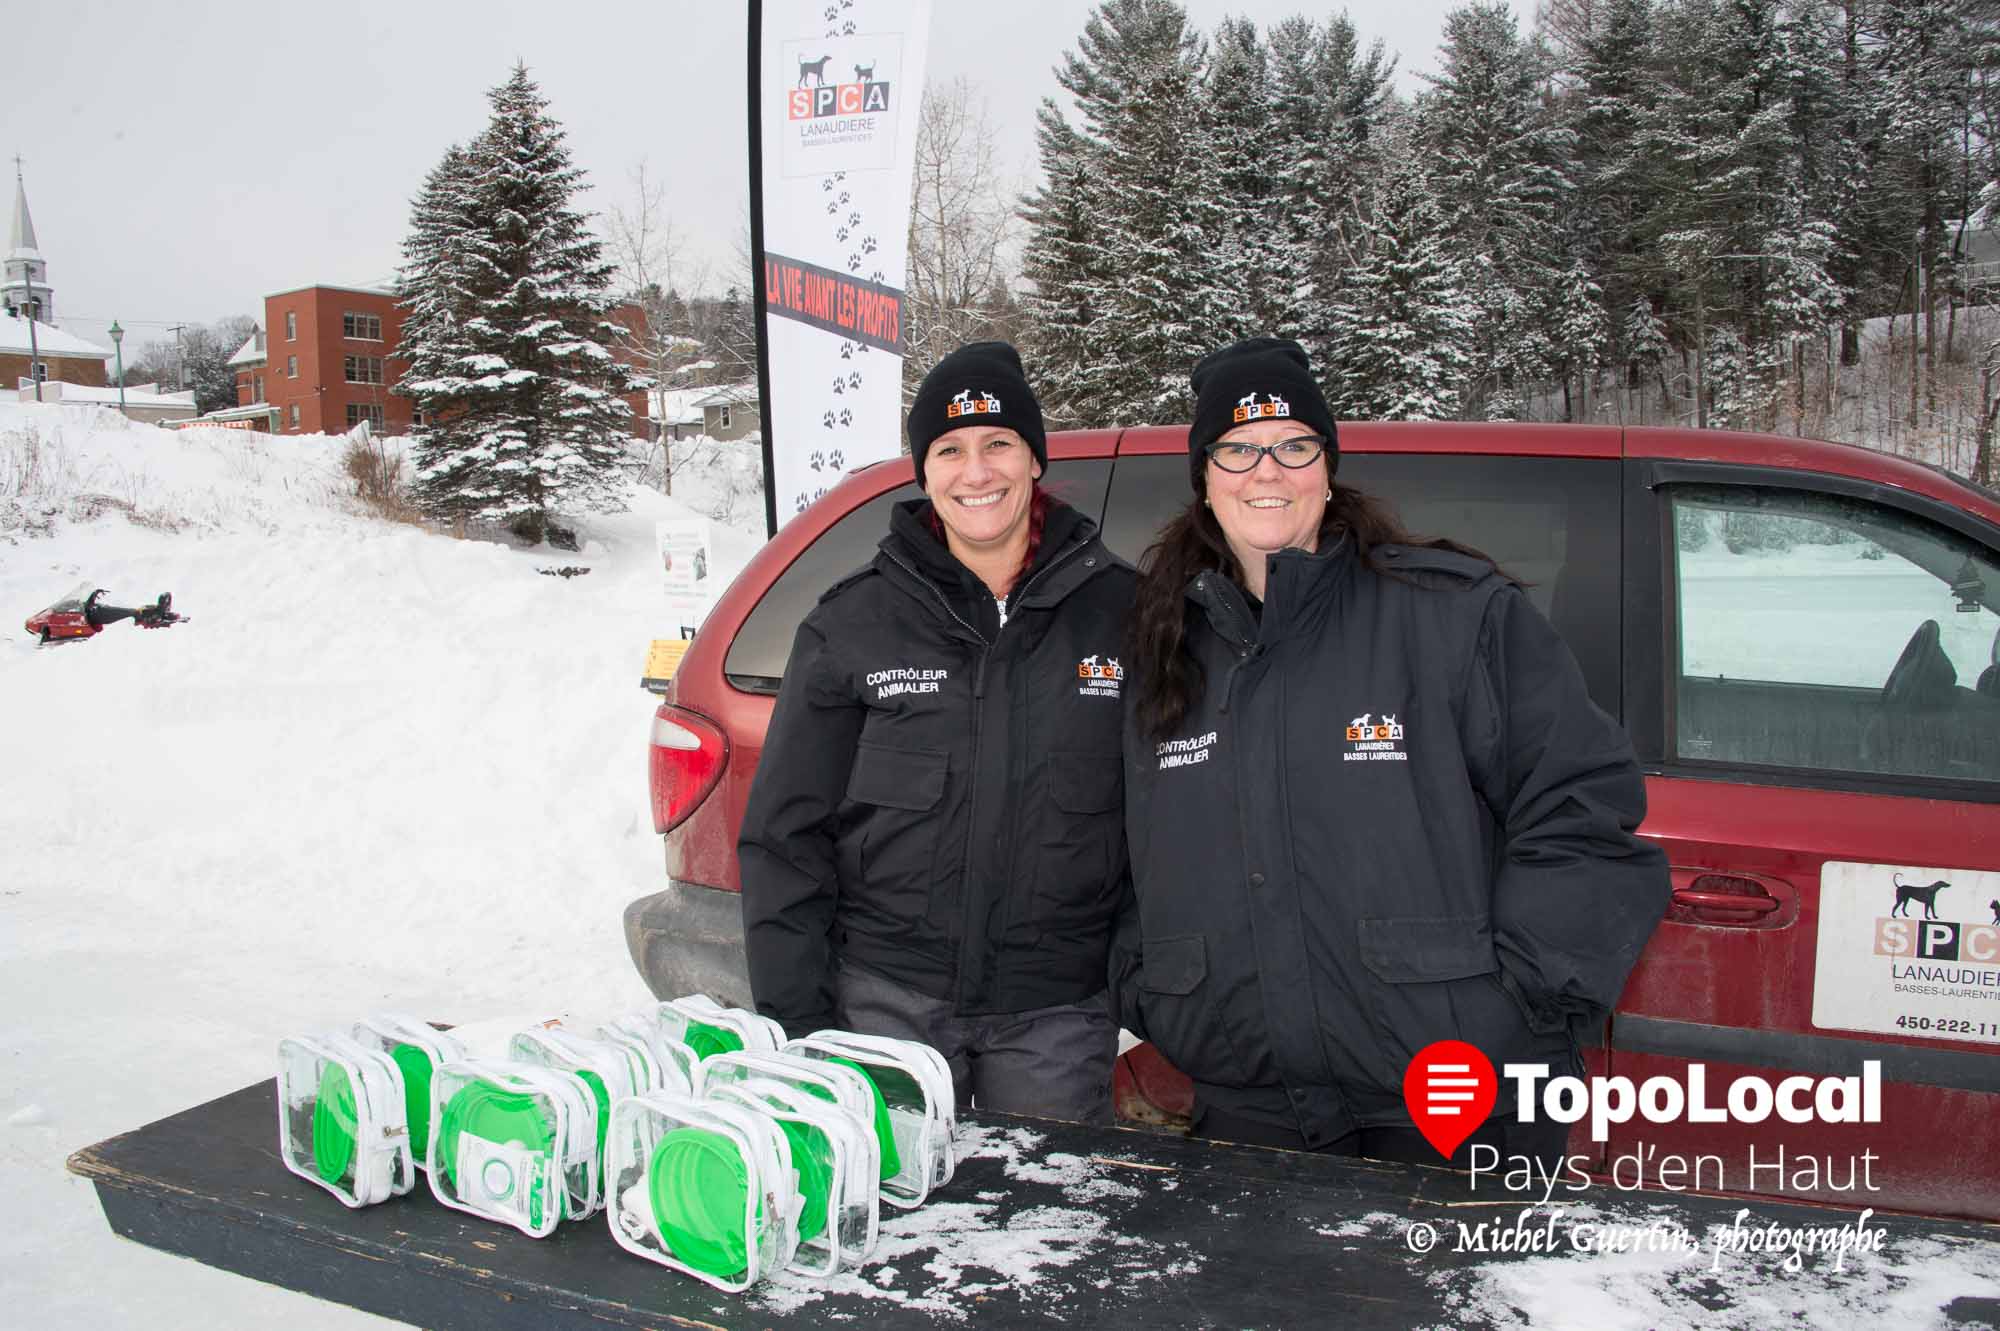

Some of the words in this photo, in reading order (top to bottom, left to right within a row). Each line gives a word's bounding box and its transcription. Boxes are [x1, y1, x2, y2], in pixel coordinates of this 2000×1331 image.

[791, 83, 888, 119] SPCA
[765, 260, 781, 304] LA
[782, 266, 804, 313] VIE
[804, 271, 836, 321] AVANT
[837, 281, 855, 329] LES
[856, 288, 899, 344] PROFITS
[949, 400, 1000, 416] SPCA
[1235, 403, 1288, 420] SPCA
[866, 667, 948, 686] CONTRÔLEUR
[1080, 665, 1122, 679] SPCA
[878, 682, 939, 700] ANIMALIER
[1347, 725, 1403, 740] SPCA
[1159, 749, 1209, 770] ANIMALIER
[1896, 1015, 1998, 1036] 450-222-11
